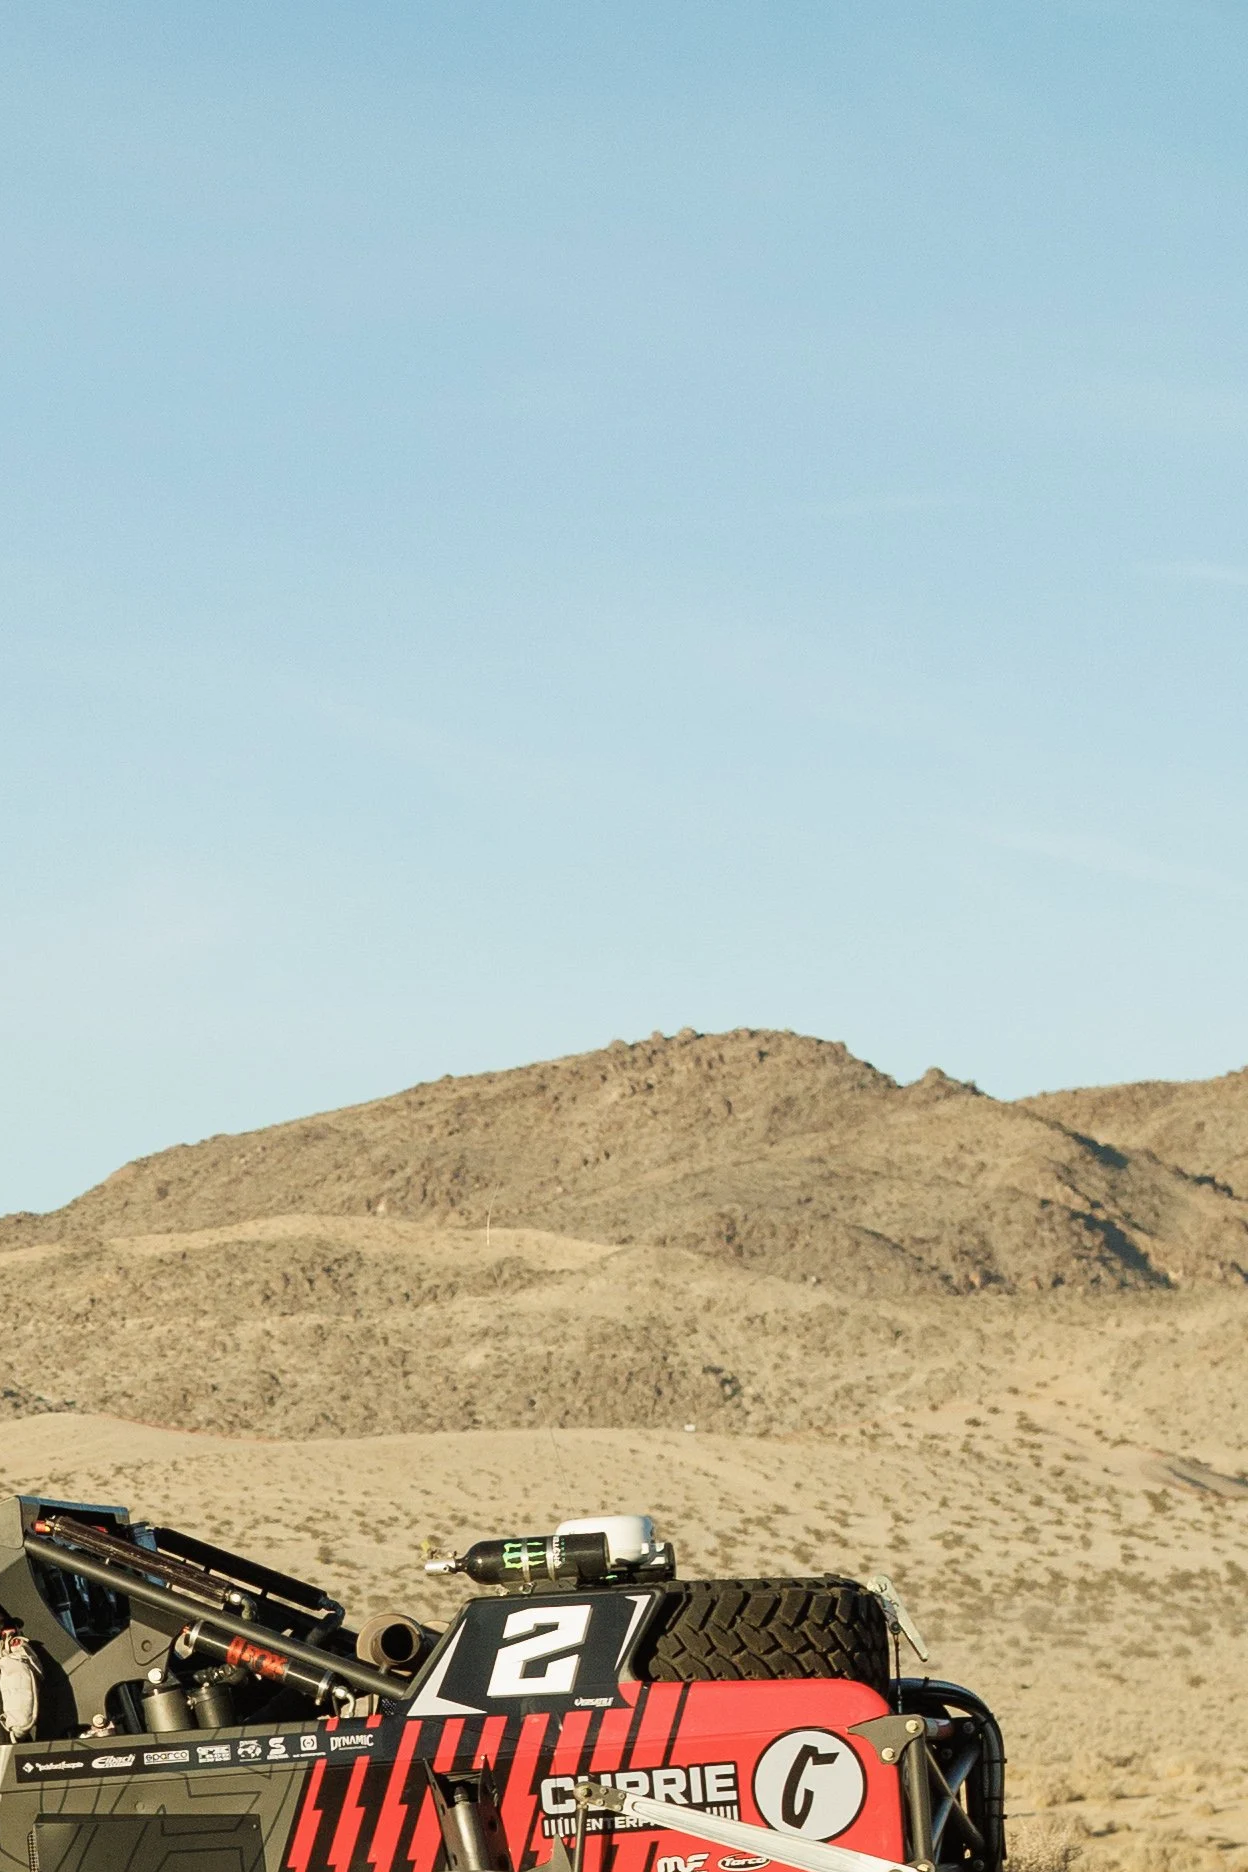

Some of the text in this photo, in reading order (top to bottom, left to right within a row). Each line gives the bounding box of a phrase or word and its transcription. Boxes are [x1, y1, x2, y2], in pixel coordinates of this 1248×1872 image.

[487, 1604, 594, 1698] 2
[330, 1734, 374, 1751] DYNAMIC
[145, 1751, 188, 1763] sparco
